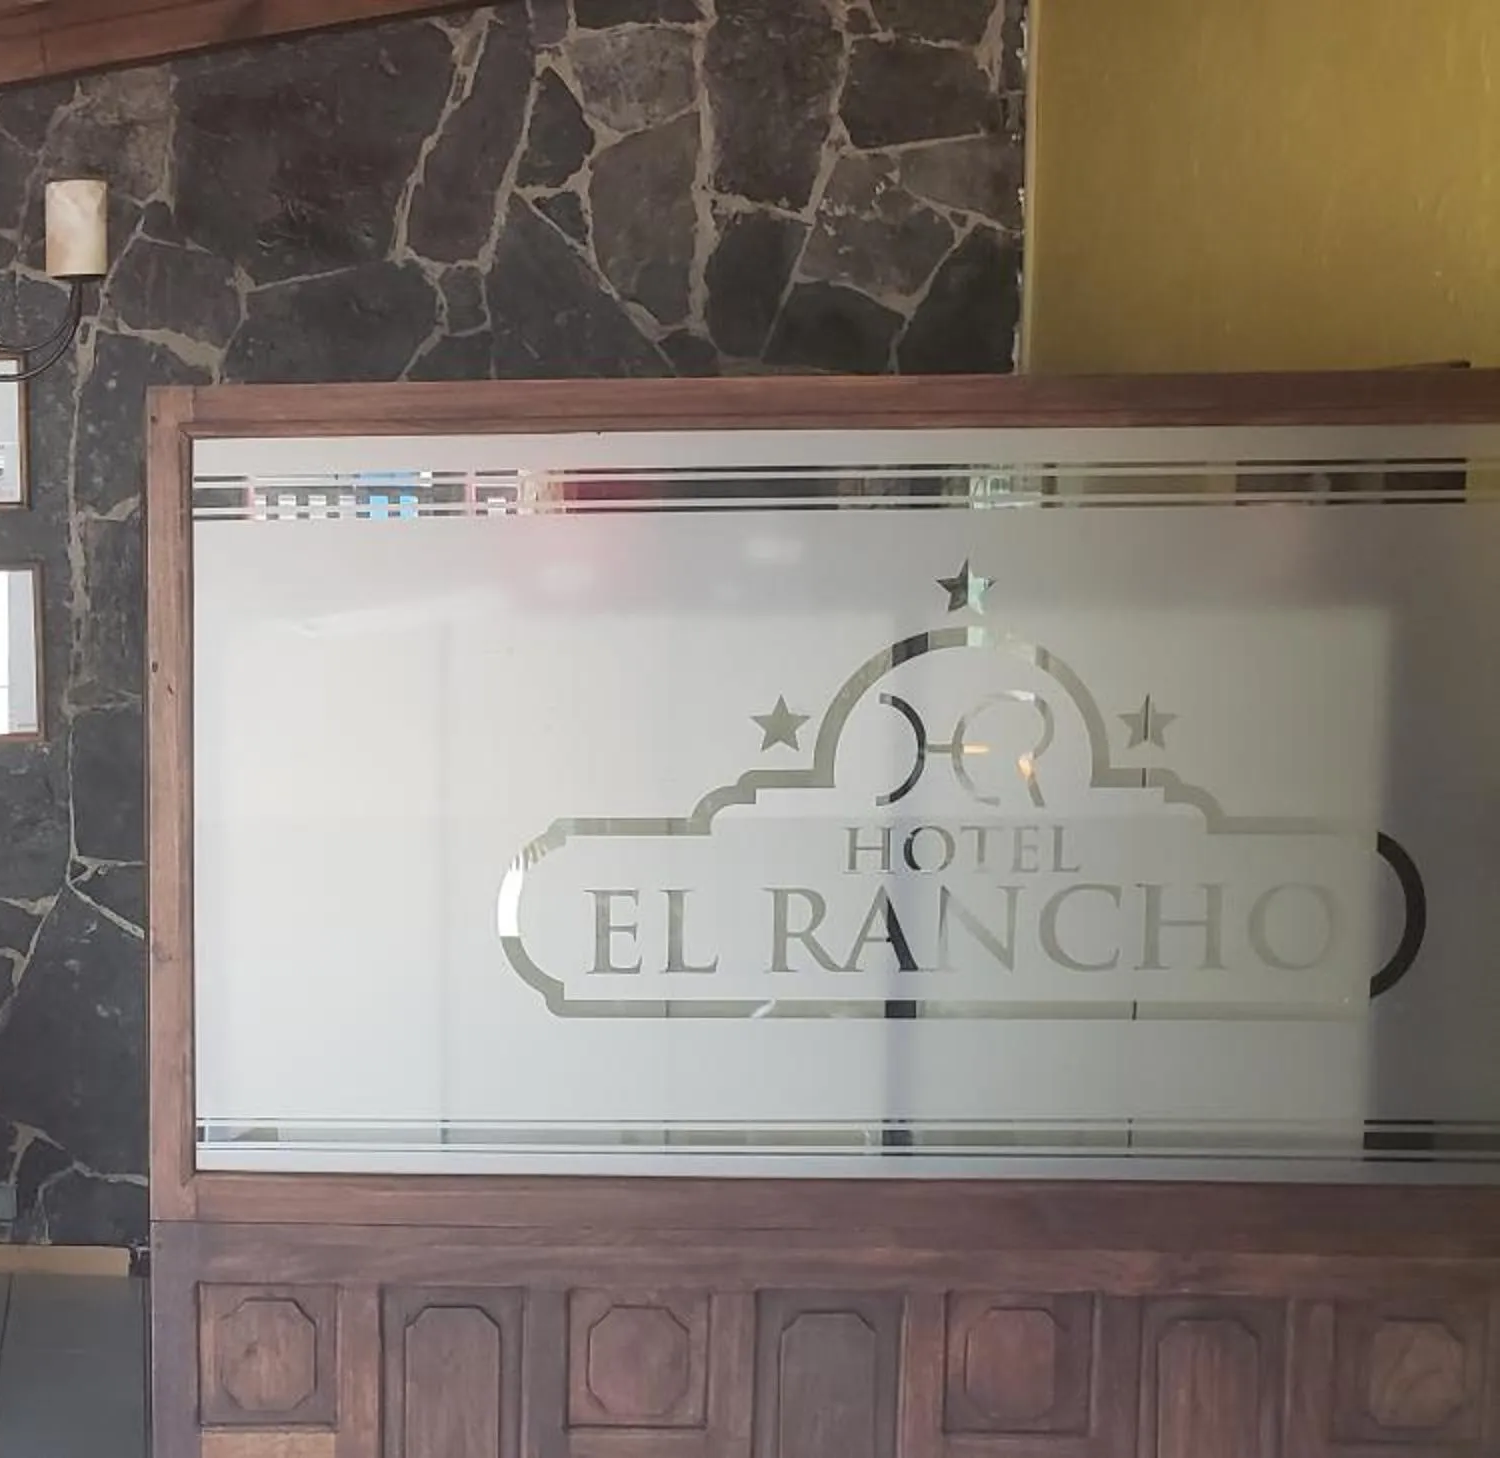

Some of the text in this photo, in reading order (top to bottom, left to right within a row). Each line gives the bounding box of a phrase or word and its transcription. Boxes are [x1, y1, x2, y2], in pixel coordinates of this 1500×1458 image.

[842, 824, 1081, 874] HOTEL
[585, 883, 1343, 975] EL RANCHO
